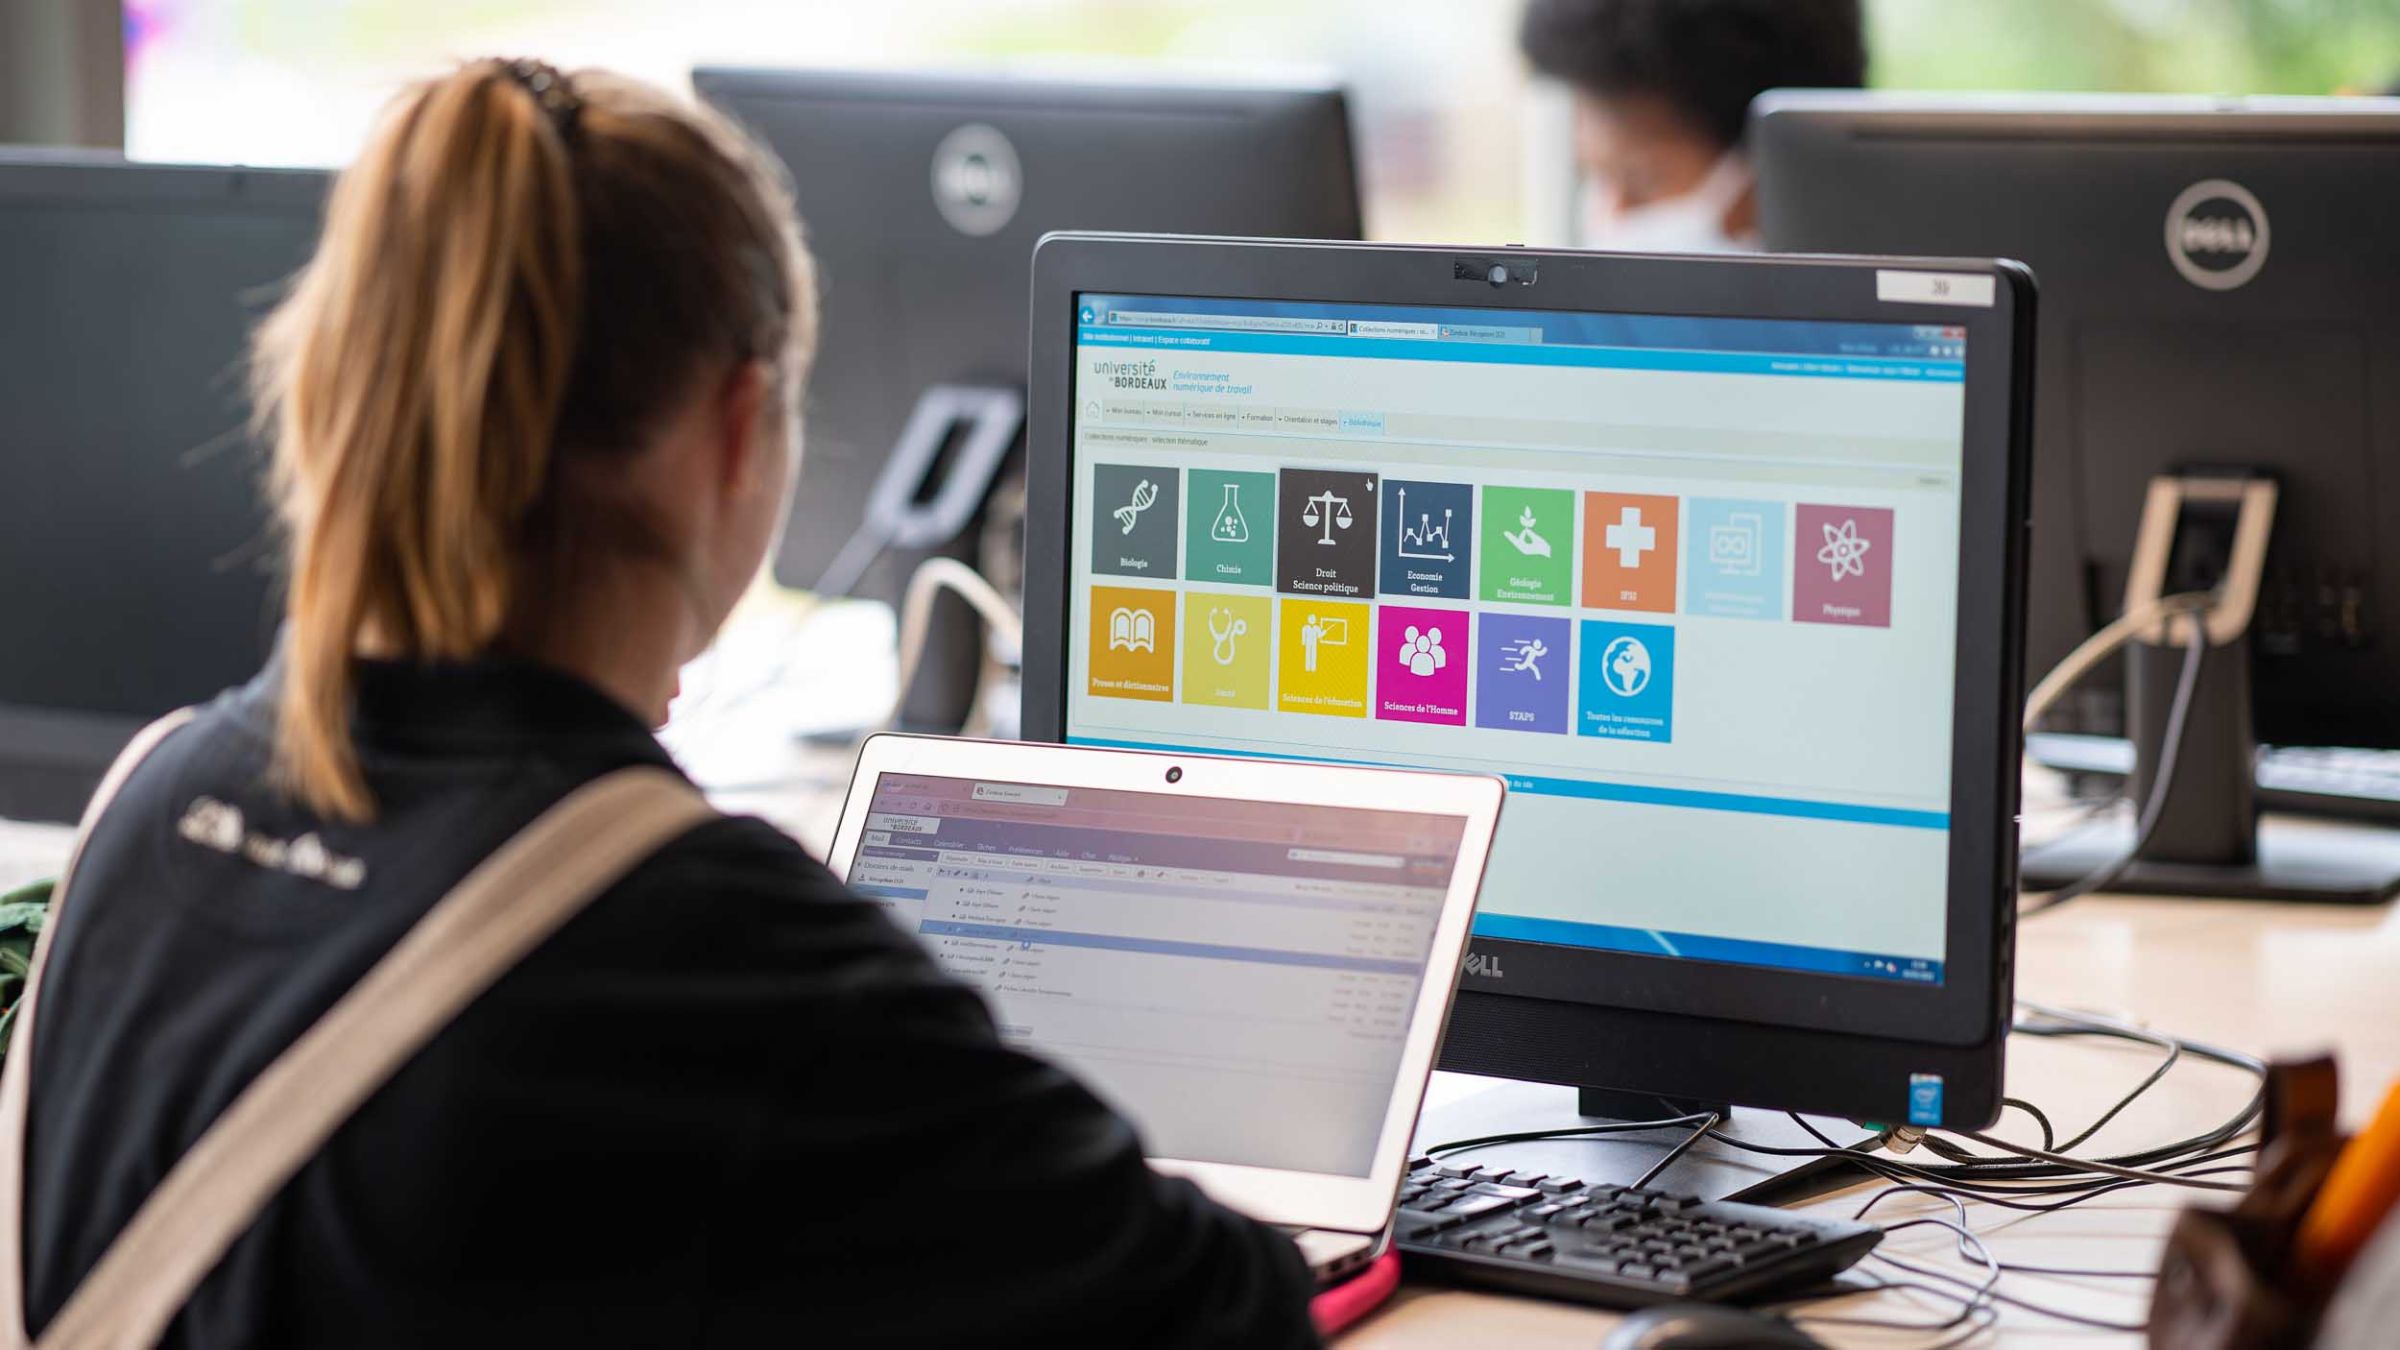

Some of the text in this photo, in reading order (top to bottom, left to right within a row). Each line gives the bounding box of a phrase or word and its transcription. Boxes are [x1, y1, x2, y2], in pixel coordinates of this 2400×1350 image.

[1094, 360, 1156, 376] université
[1172, 370, 1230, 382] Environnement
[1115, 376, 1167, 390] BORDEAUX
[1173, 383, 1213, 393] numérique
[1227, 384, 1253, 395] travail
[1120, 557, 1148, 570] Biologie
[1216, 564, 1242, 575] Chimie
[1316, 567, 1337, 578] Droit
[1407, 570, 1443, 582] Economie
[1293, 579, 1359, 595] Science politique
[1410, 583, 1439, 594] Gestion
[1282, 693, 1362, 708] Sciences de l'éducation
[1384, 701, 1458, 716] Sciences de l'Homme
[1509, 711, 1535, 722] STAPS
[1585, 711, 1611, 722] Toutes
[1598, 725, 1608, 734] de
[1465, 952, 1504, 978] ELL
